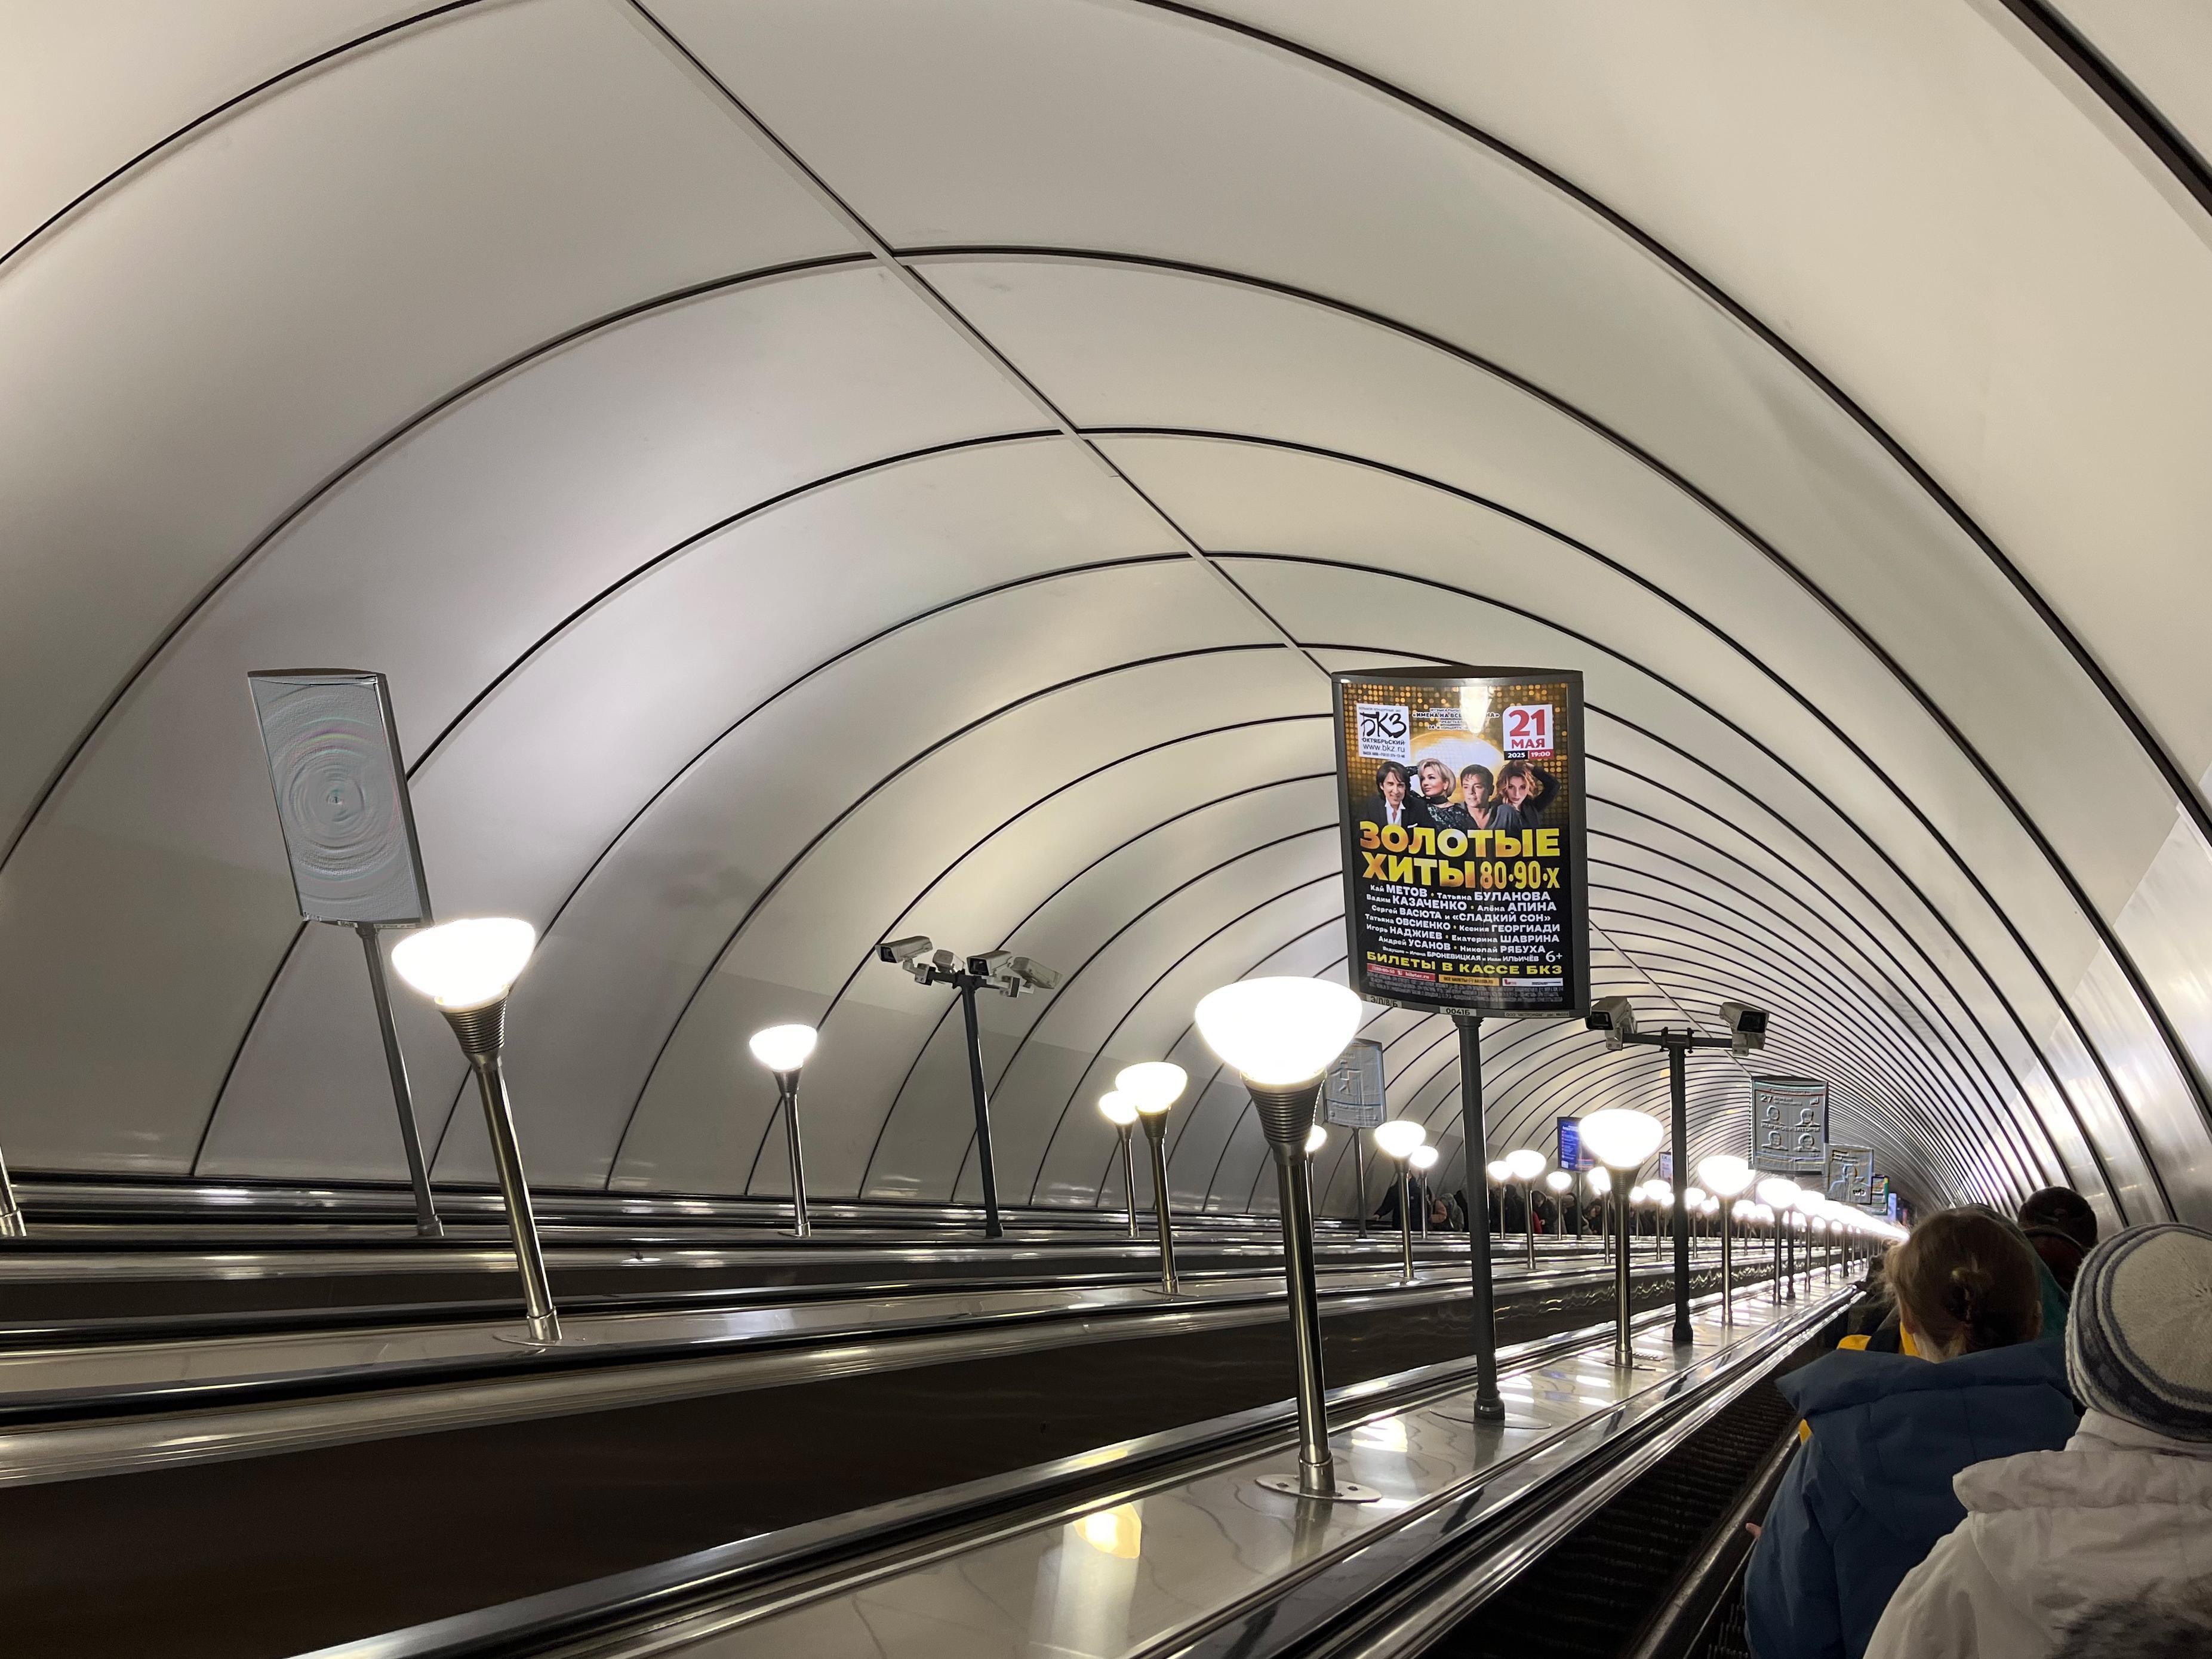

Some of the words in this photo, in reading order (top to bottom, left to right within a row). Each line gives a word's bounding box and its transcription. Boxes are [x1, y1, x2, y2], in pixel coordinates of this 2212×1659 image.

[1359, 712, 1407, 738] БКЗ
[1509, 709, 1545, 737] 21
[1362, 737, 1405, 746] ОКТЯБРЬСКИЙ
[1363, 744, 1405, 753] www.bkz.ru
[1512, 738, 1545, 749] МАЯ
[1359, 821, 1560, 858] ЗОЛОТЫЕ
[1361, 851, 1476, 888] ХИТЫ
[1386, 884, 1428, 897] МЕТОВ
[1474, 891, 1550, 901] БУЛАНОВА
[1366, 894, 1391, 903] Вадим
[1392, 895, 1467, 911] КАЗАЧЕНКО
[1508, 901, 1557, 912] АПИНА
[1371, 904, 1398, 914] Сергей
[1399, 907, 1442, 919] ВАСЮТА
[1452, 911, 1516, 923] «СЛАДКИЙ
[1519, 913, 1551, 922] СОН»
[1365, 913, 1394, 924] Татьяна
[1395, 917, 1451, 931] ОВСИЕНКО
[1491, 924, 1560, 933] ГЕОРГИАДИ
[1366, 924, 1388, 933] Игорь
[1389, 926, 1442, 940] НАДЖИЕВ
[1451, 934, 1498, 943] Екатерина
[1500, 934, 1560, 943] ШАВРИНА
[1379, 935, 1407, 946] Андрей
[1408, 938, 1451, 950] УСАНОВ
[1500, 945, 1546, 953] РЯБУХА
[1367, 951, 1436, 970] БИЛЕТЫ
[1442, 962, 1453, 971] В
[1459, 964, 1520, 974] КАССЕ
[1526, 965, 1562, 974] БКЗ
[1427, 951, 1481, 961] БРОНЕВИЦКАЯ
[1545, 950, 1563, 962] 6+
